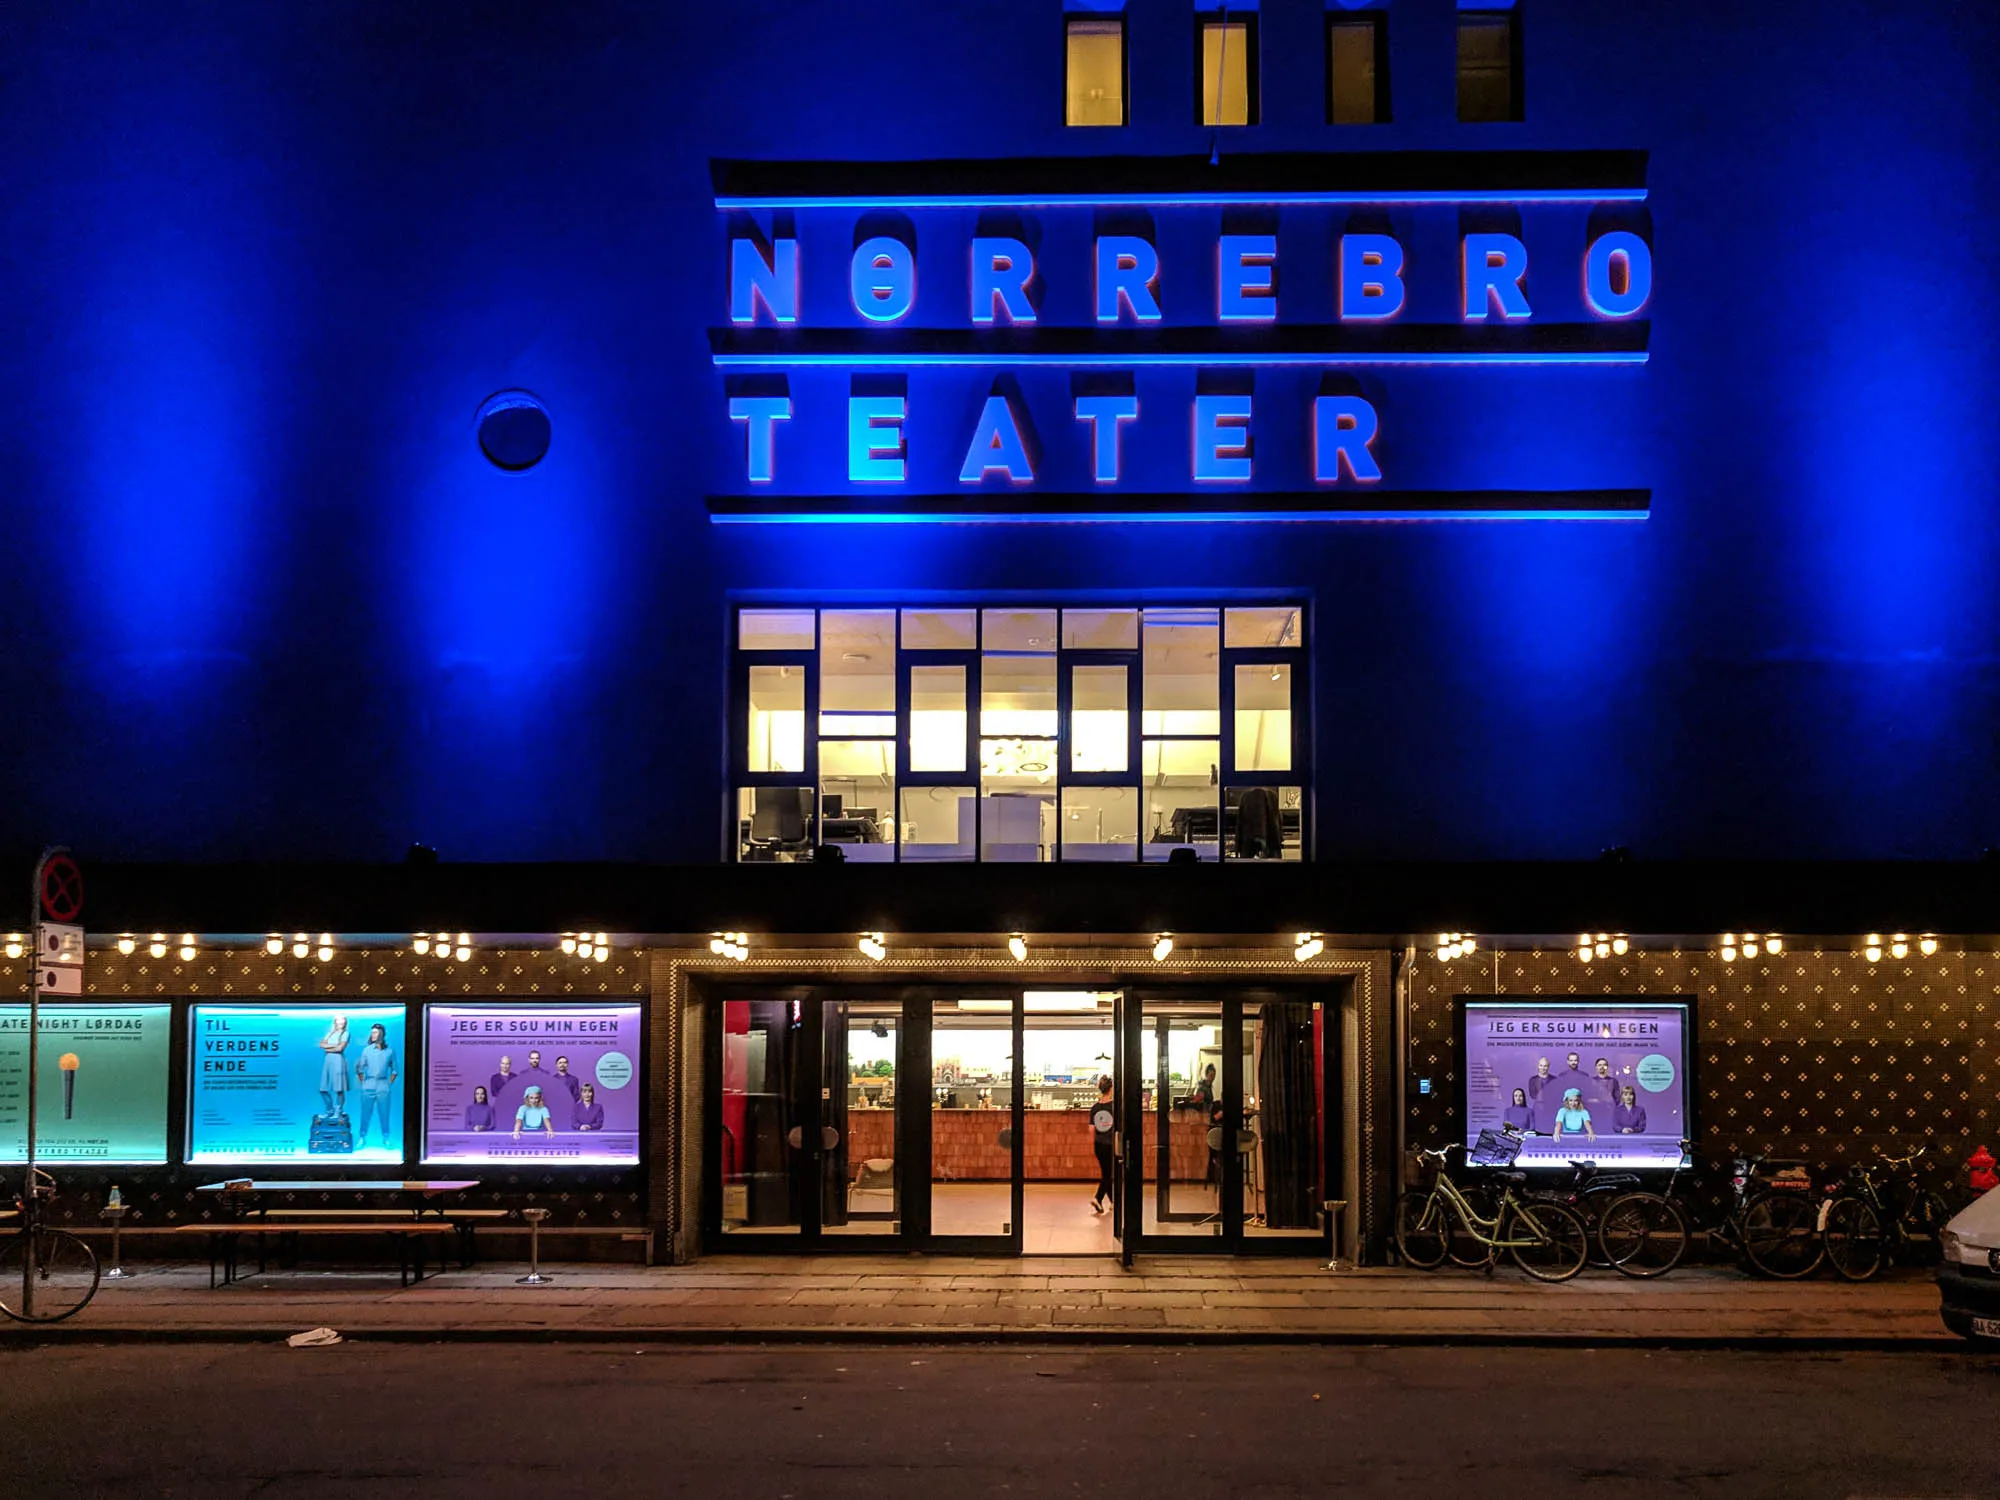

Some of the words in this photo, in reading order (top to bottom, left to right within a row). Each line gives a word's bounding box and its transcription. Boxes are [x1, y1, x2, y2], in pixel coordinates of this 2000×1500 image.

[730, 231, 1653, 322] NØRREBRO
[729, 395, 1382, 482] TEATER
[0, 1019, 28, 1029] ATE
[36, 1019, 80, 1029] NIGHT
[86, 1019, 143, 1030] LØRDAG
[205, 1019, 231, 1031] TIL
[451, 1020, 478, 1032] JEG
[485, 1020, 504, 1032] ER
[509, 1020, 538, 1032] SGU
[545, 1020, 573, 1032] MIN
[579, 1020, 618, 1032] EGEN
[1488, 1022, 1514, 1033] JEG
[1521, 1022, 1540, 1033] ER
[1547, 1022, 1576, 1033] SGU
[1583, 1023, 1611, 1034] MIN
[1618, 1023, 1658, 1034] EGEN
[205, 1040, 280, 1052] VERDENS
[204, 1060, 247, 1072] ENDE
